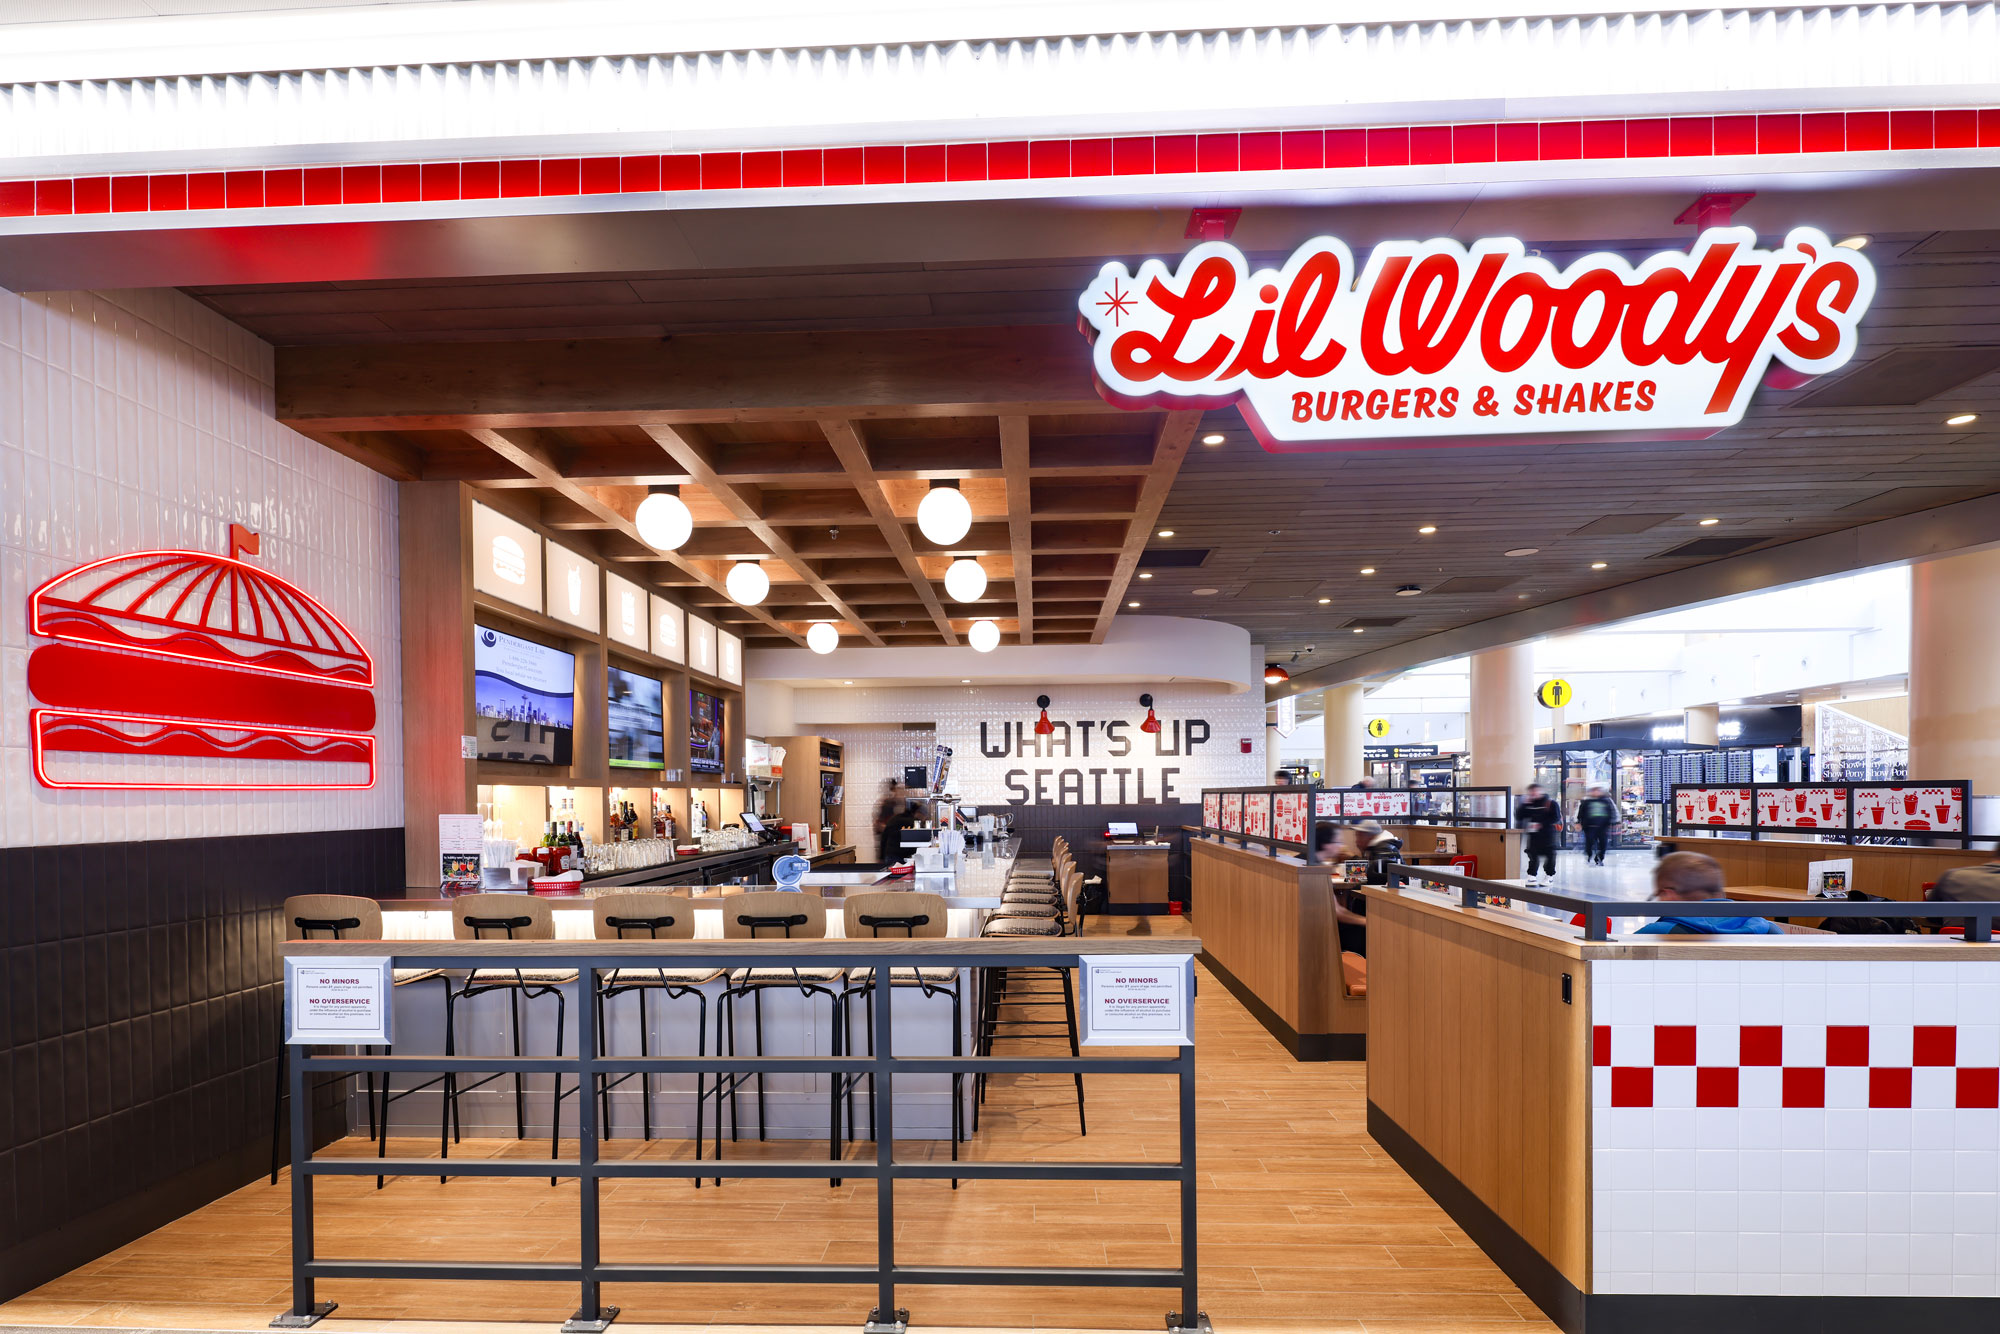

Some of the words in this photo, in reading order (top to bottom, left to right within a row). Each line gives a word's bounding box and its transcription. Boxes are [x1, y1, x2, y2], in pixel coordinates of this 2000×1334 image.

[1110, 251, 1347, 382] Lil
[1360, 242, 1859, 415] Woody's
[1291, 386, 1459, 423] BURGERS
[1472, 385, 1499, 416] &
[1513, 380, 1657, 416] SHAKES
[980, 720, 1132, 758] WHAT'S
[1155, 719, 1211, 756] UP
[1005, 767, 1181, 806] SEATTLE
